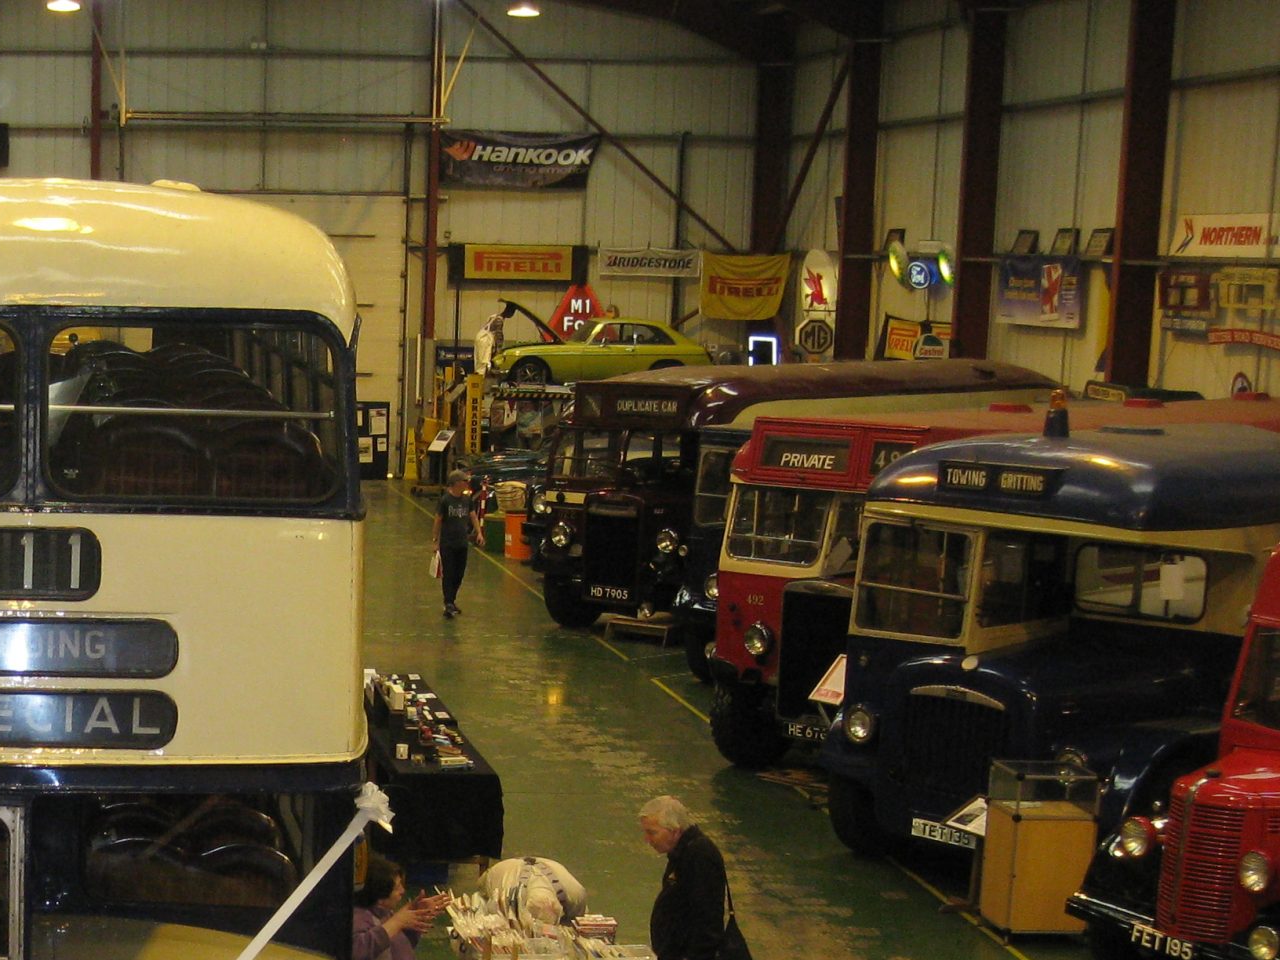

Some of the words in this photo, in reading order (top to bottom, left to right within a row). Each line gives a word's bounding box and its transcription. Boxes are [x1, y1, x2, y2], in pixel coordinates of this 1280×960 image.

[1199, 226, 1262, 247] NORTHERN
[474, 251, 563, 273] PIRELLI
[606, 255, 694, 270] BRIDGESTONE
[709, 275, 783, 298] PIRELLI
[804, 321, 829, 350] MG
[617, 400, 659, 412] DUPLICATE
[662, 401, 678, 412] CAR
[780, 453, 835, 470] PRIVATE
[946, 468, 987, 487] TOWING
[1000, 473, 1044, 492] GRITTING
[590, 586, 603, 598] HD
[605, 587, 628, 600] 7905
[747, 594, 765, 606] 492
[788, 724, 803, 737] HE
[921, 823, 946, 841] TET
[1131, 924, 1164, 951] FET
[1165, 936, 1193, 960] 195
